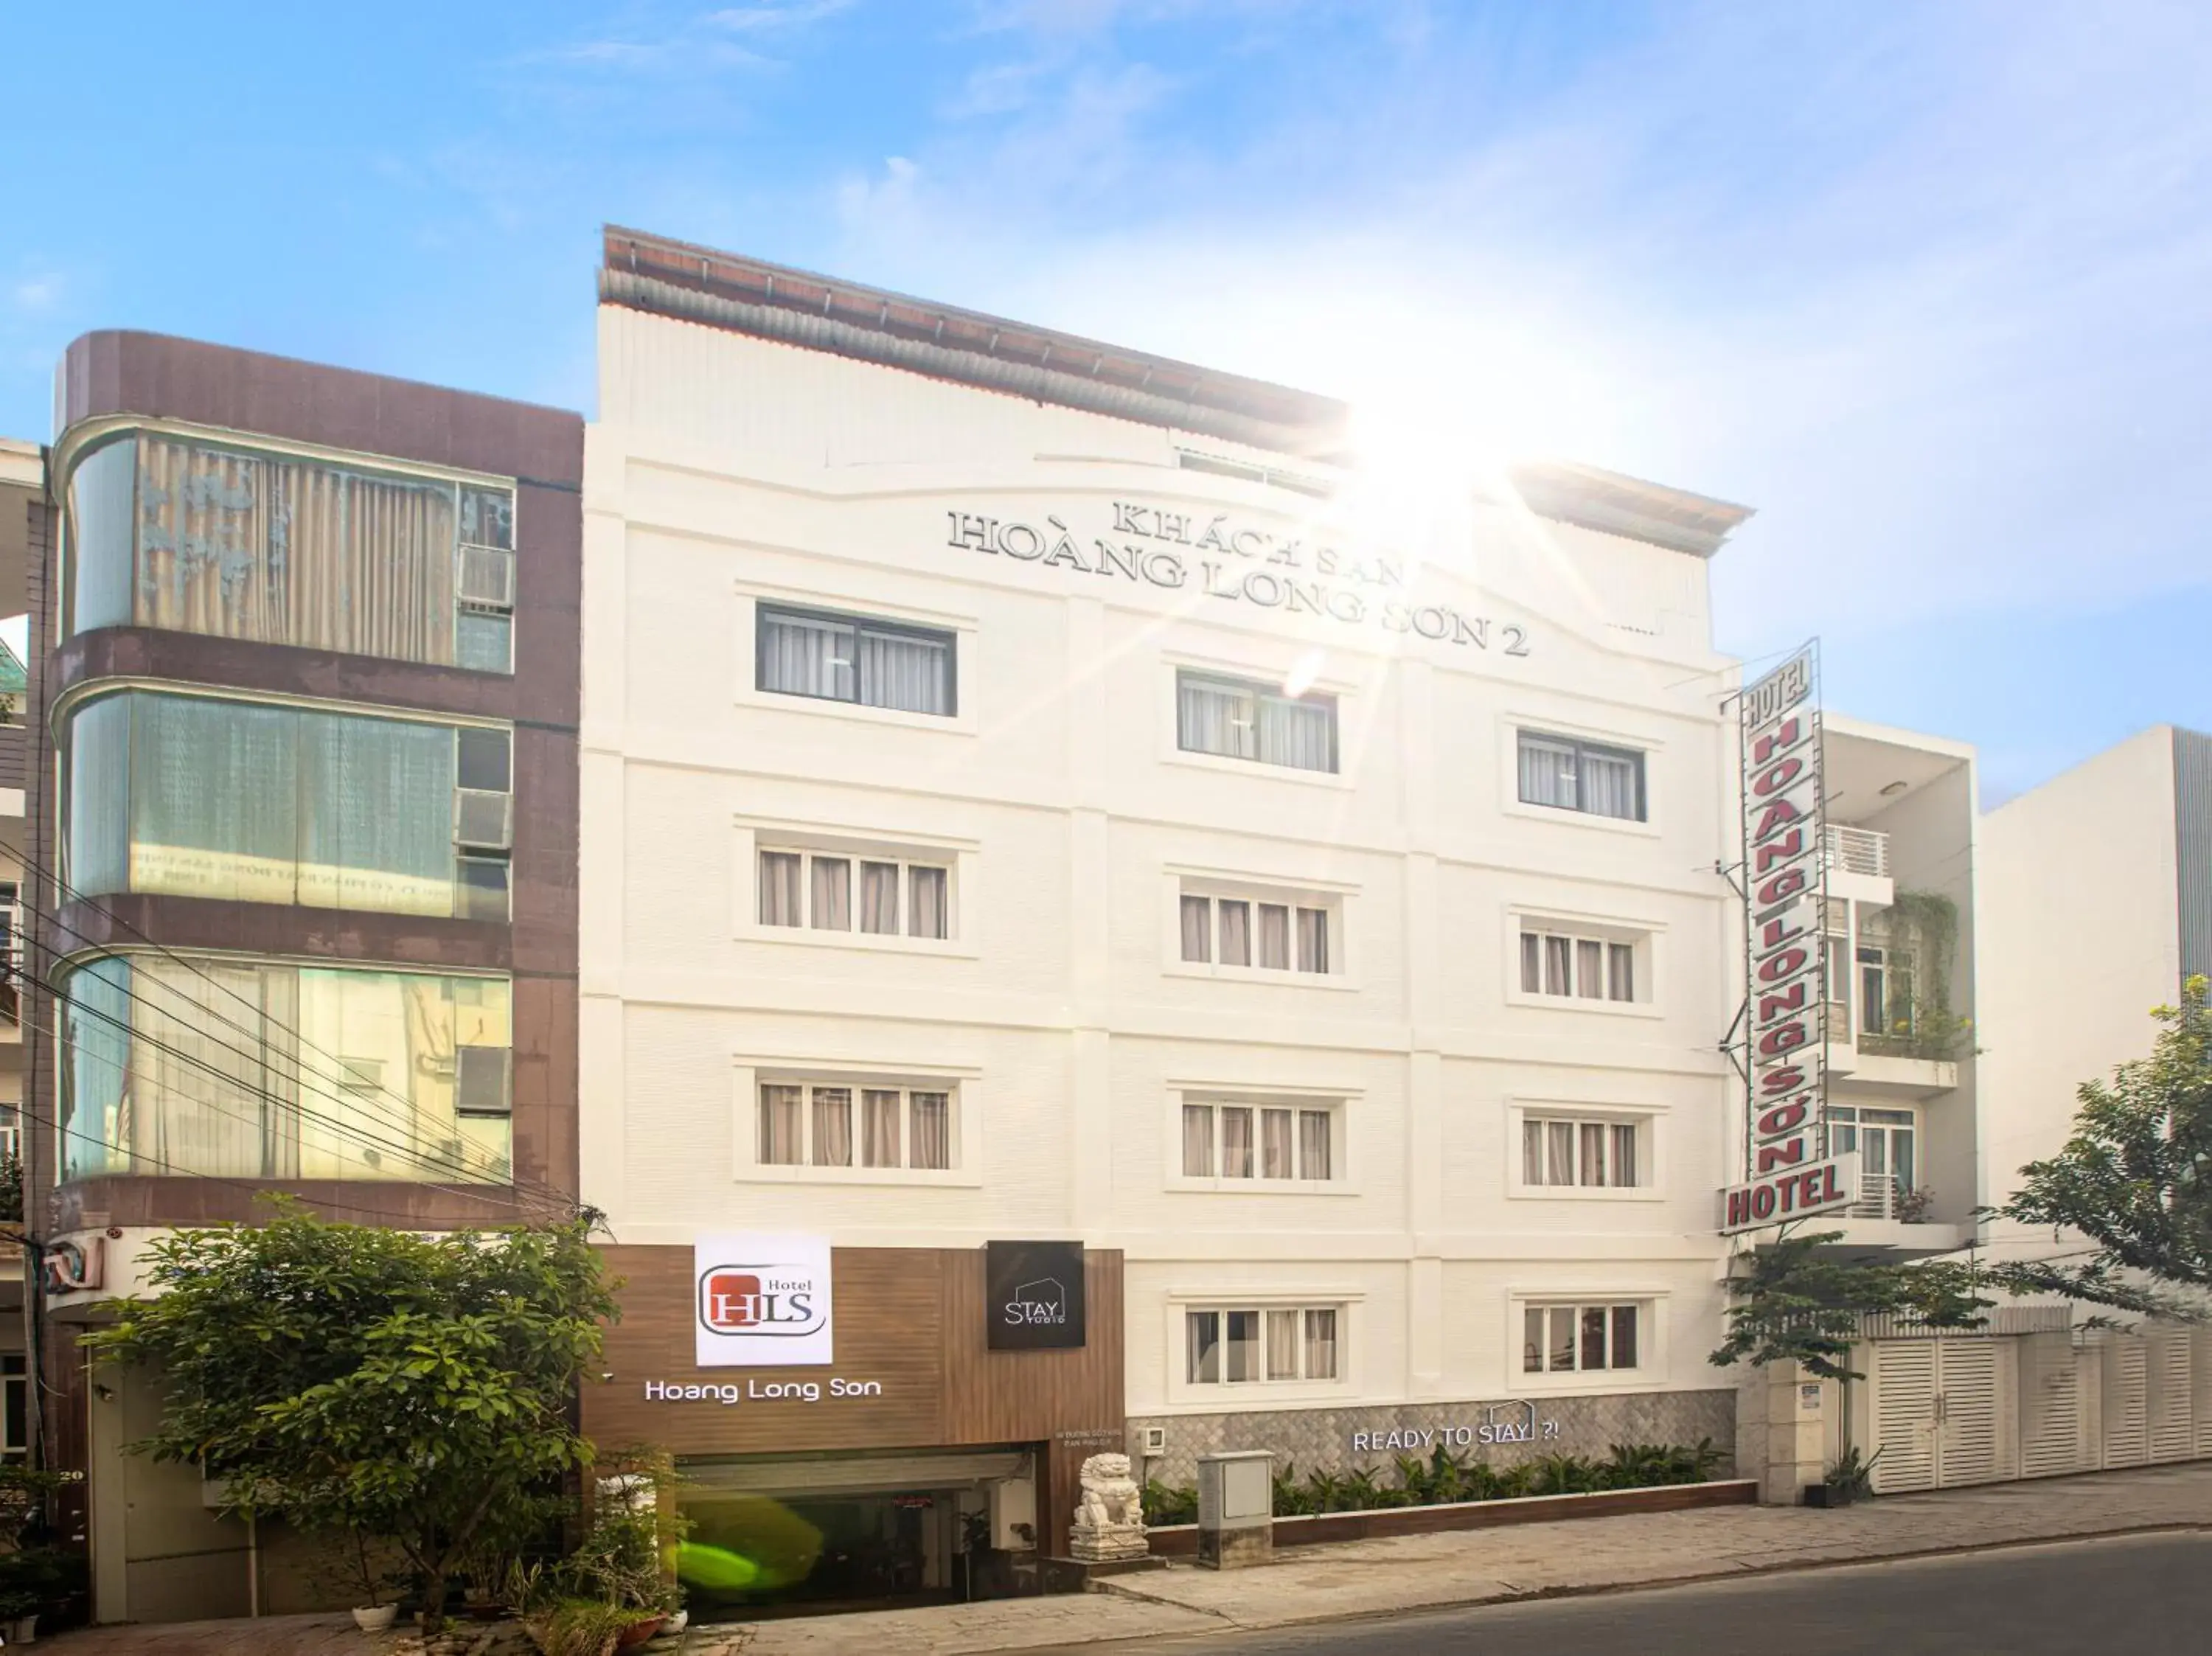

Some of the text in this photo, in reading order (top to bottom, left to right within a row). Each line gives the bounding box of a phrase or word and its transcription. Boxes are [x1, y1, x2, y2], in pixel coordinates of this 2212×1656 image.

[948, 512, 1187, 589] HOÀNG
[1203, 560, 1367, 623] LONG
[1501, 623, 1531, 657] 2
[1748, 658, 1809, 728] HOTEL
[1758, 919, 1808, 1056] LONG
[1728, 1163, 1845, 1228] HOTEL
[769, 1279, 812, 1291] Hotel
[712, 1293, 813, 1323] HLS
[1005, 1301, 1058, 1325] STAY
[644, 1377, 882, 1405] Hoang Long Son
[1354, 1428, 1435, 1452] READY
[1442, 1426, 1472, 1447] TO
[1479, 1423, 1530, 1444] STAY
[59, 1470, 84, 1481] 20
